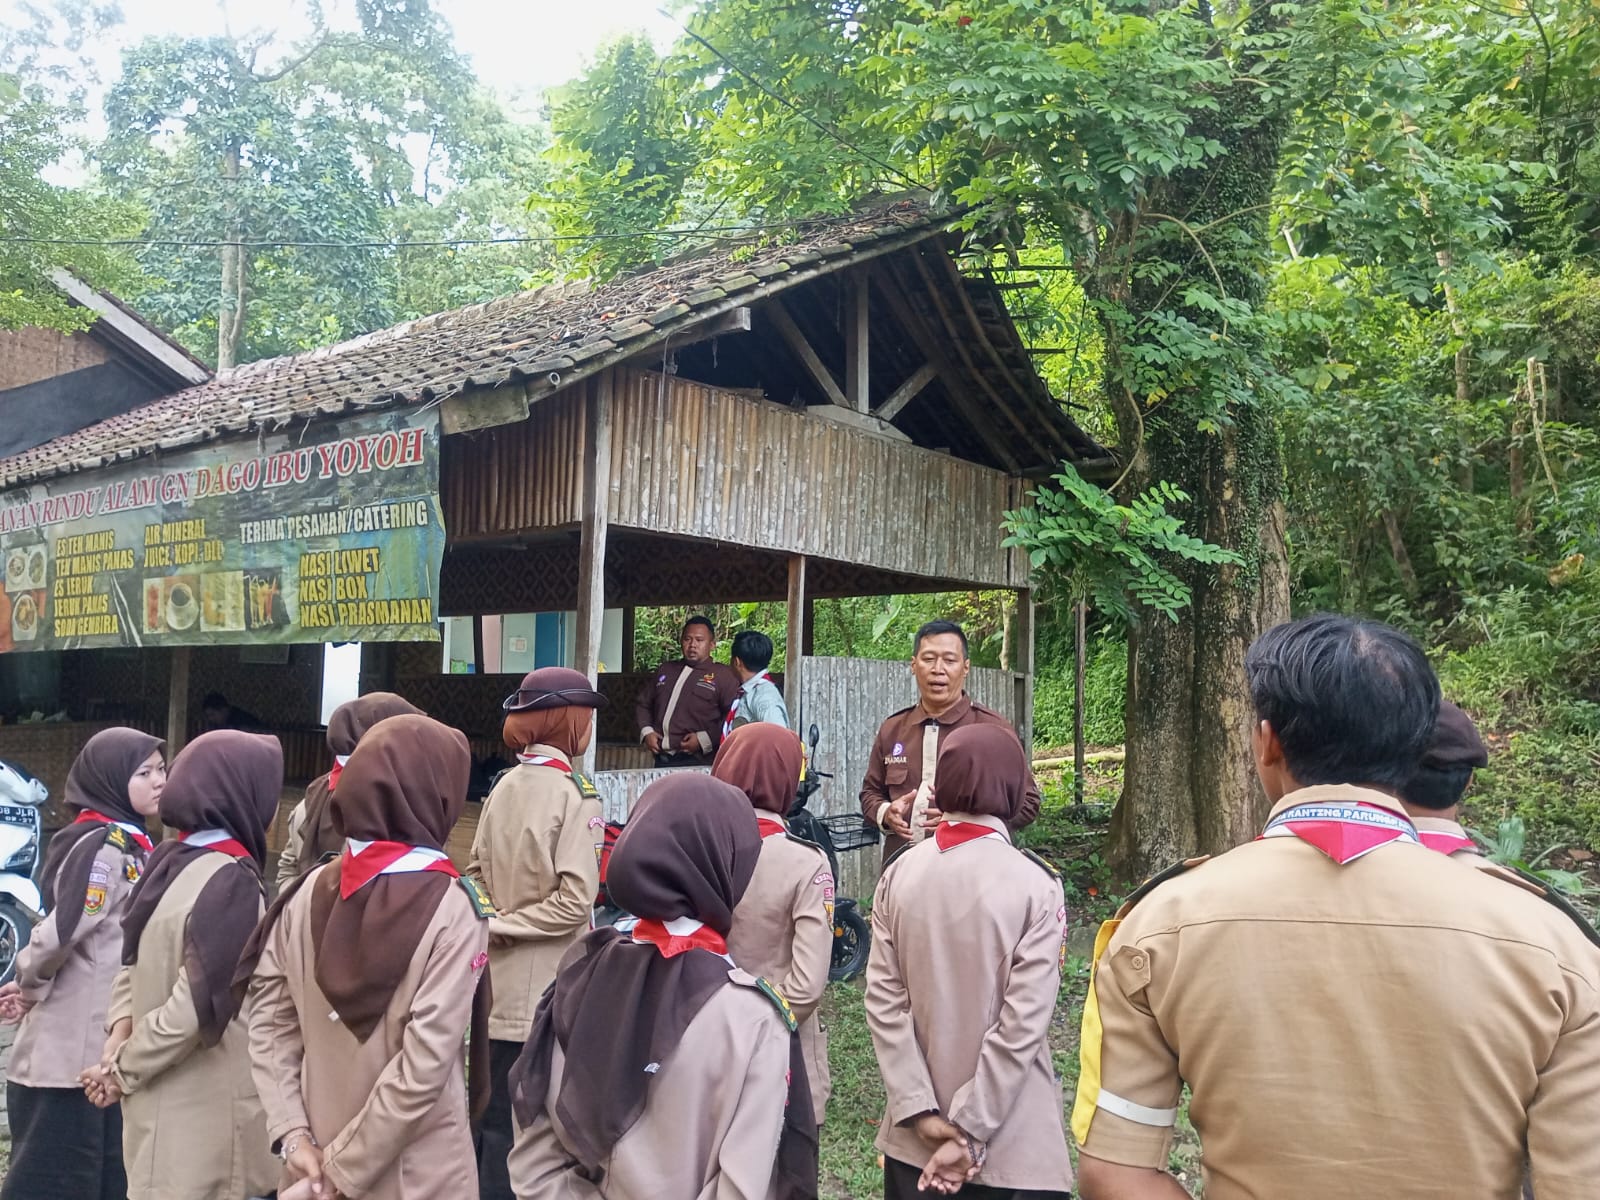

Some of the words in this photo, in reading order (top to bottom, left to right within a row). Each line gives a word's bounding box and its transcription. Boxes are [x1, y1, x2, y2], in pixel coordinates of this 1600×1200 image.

[41, 487, 100, 526] RINDU
[100, 475, 159, 514] ALAM
[161, 470, 193, 505] GN
[195, 457, 261, 499] DAGO
[263, 446, 313, 487] IBU
[317, 427, 425, 479] YOYOH
[85, 530, 115, 553] MANIS
[145, 524, 160, 546] AIR
[162, 518, 206, 544] MINERAL
[240, 516, 285, 544] TERIMA
[102, 549, 134, 571] PANAS
[300, 551, 332, 577] NASI
[334, 547, 380, 573] LIWET
[300, 577, 332, 602] NASI
[336, 575, 368, 601] BOX
[301, 602, 336, 628] NASI
[337, 598, 432, 626] PRASMANAN
[1288, 808, 1341, 820] RANTING
